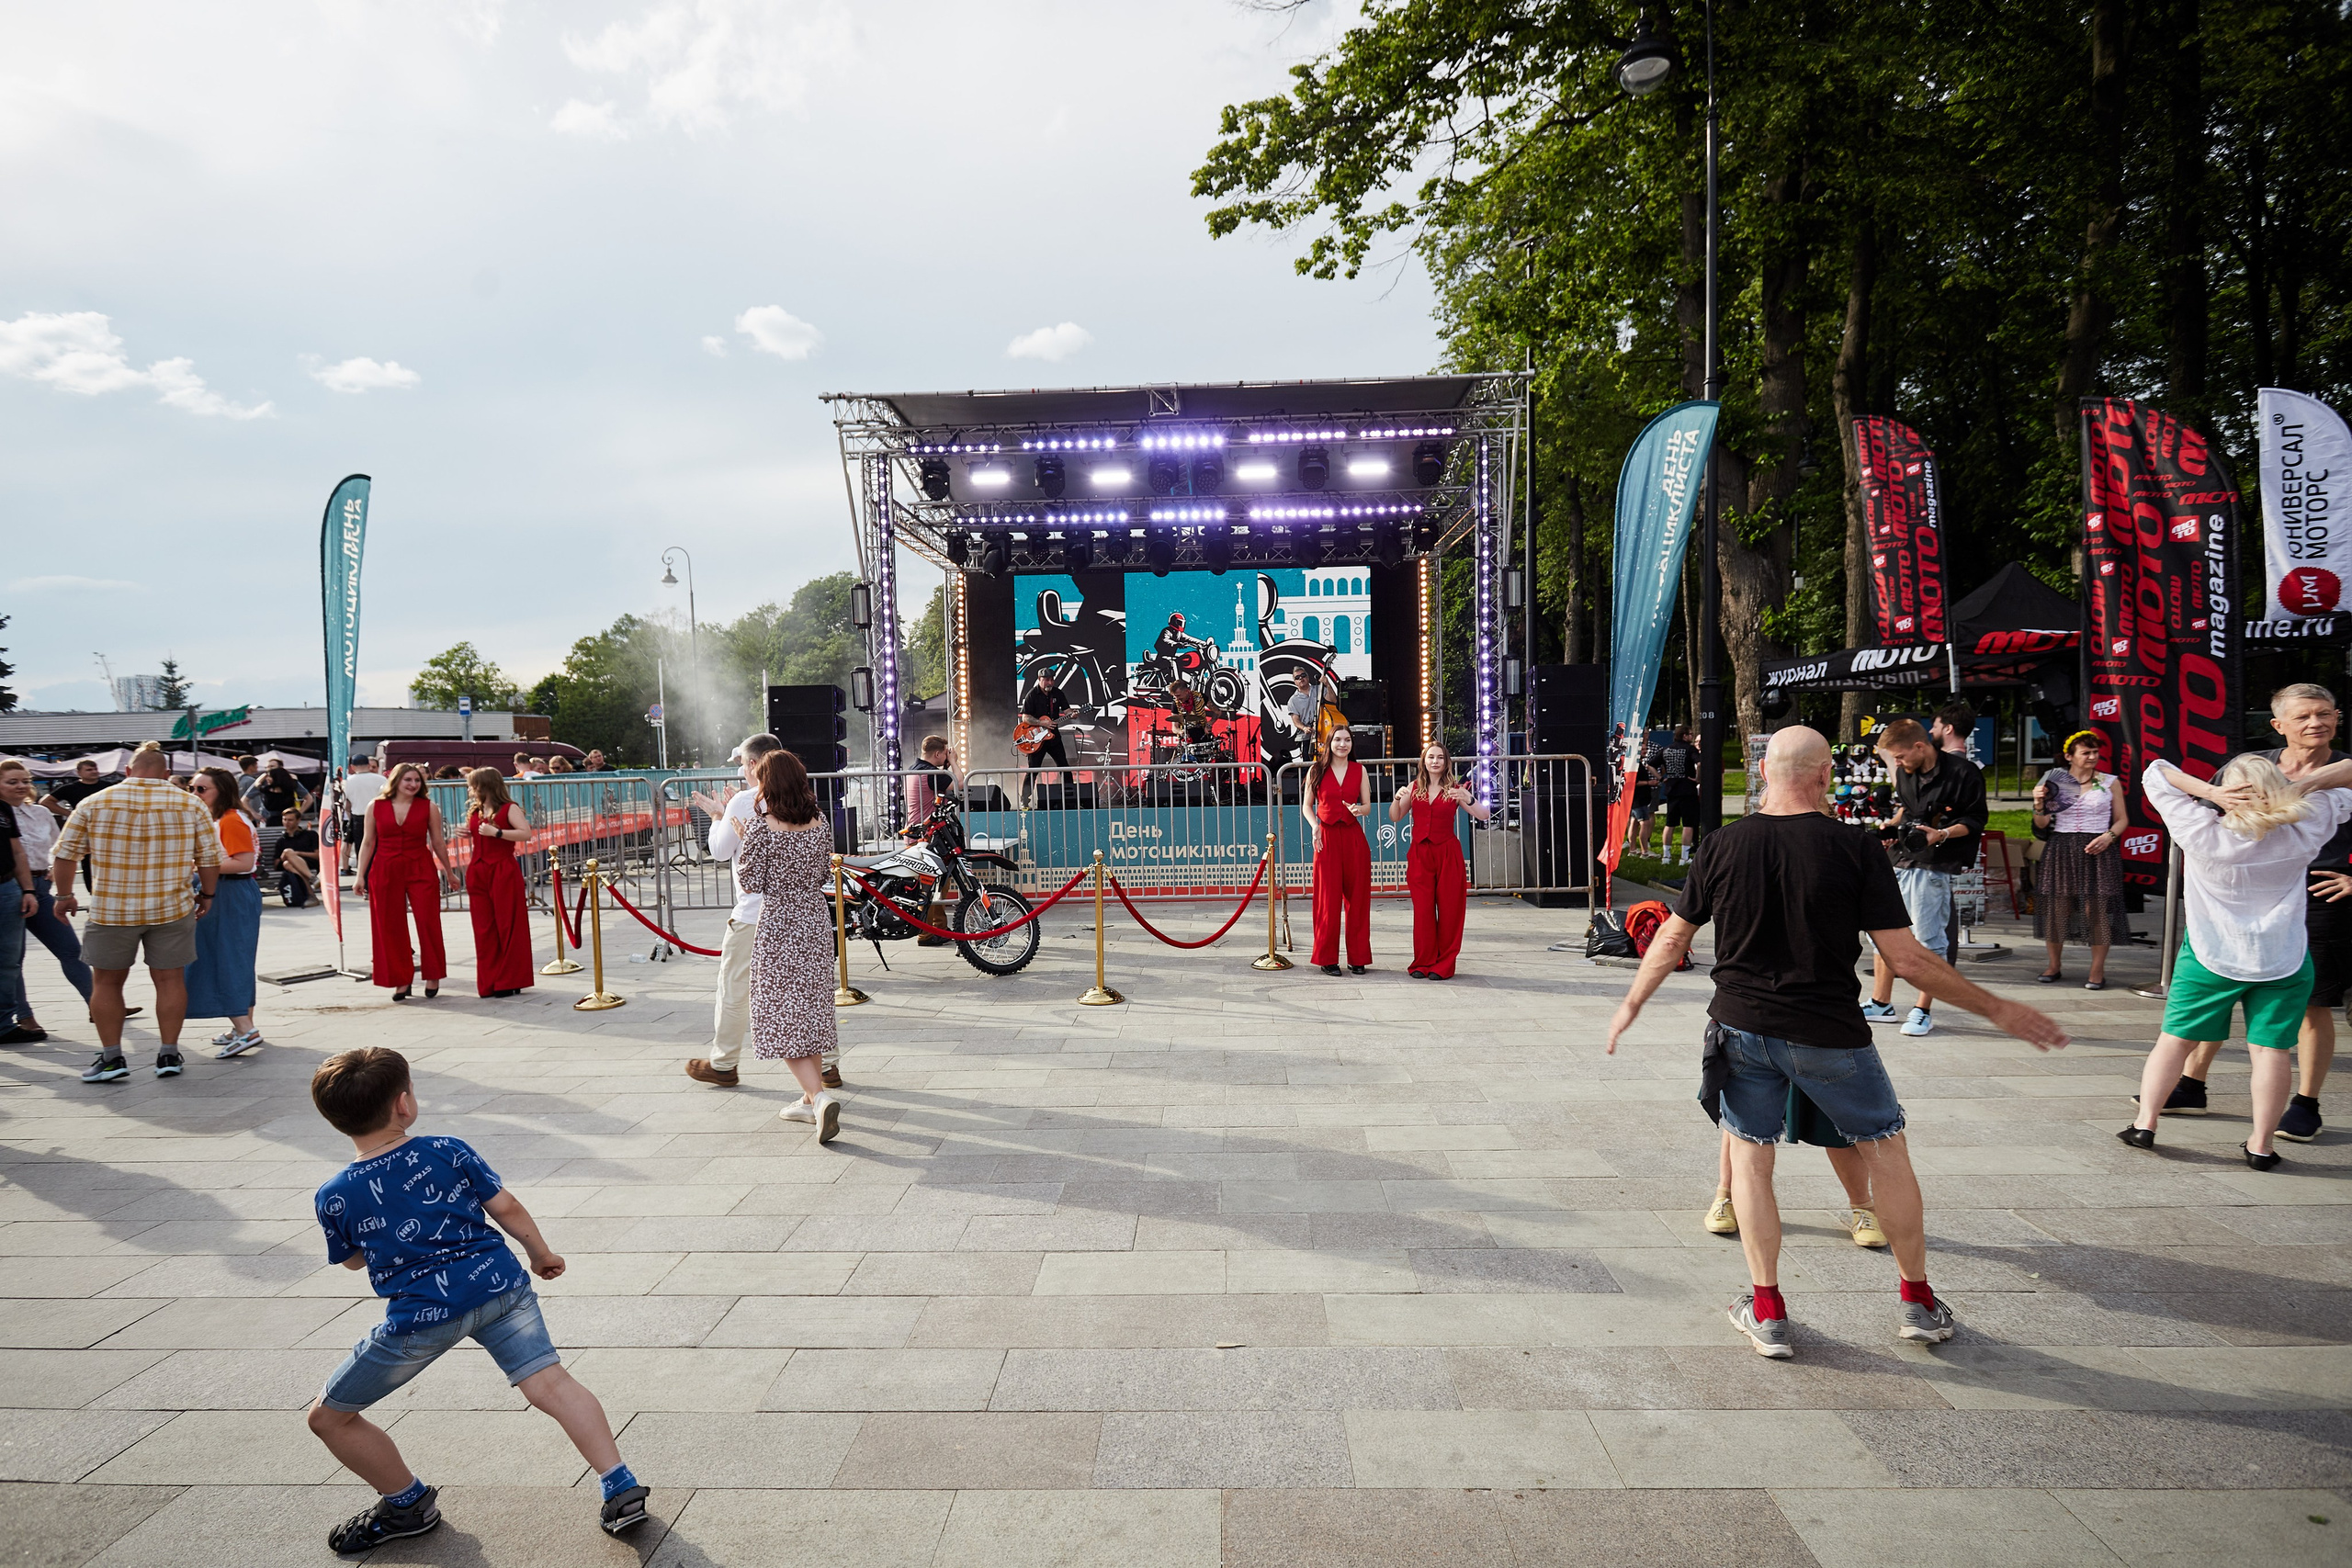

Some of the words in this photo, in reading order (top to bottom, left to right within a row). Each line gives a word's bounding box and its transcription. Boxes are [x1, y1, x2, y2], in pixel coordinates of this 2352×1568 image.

[1663, 429, 1682, 497] ДЕНЬ
[2090, 422, 2107, 505] MOTO
[2144, 410, 2161, 471] MOTO
[1924, 460, 1938, 528] magazine
[2105, 397, 2136, 546] MOTO
[1888, 460, 1908, 540] MOTO
[2305, 468, 2329, 559] МОТОРС
[344, 499, 355, 556] ДЕНЬ
[2171, 519, 2197, 535] MO
[2175, 526, 2196, 538] TO
[1898, 549, 1914, 613] MOTO
[1916, 526, 1945, 643] MOTO
[2119, 563, 2134, 637] MOTO
[2133, 502, 2166, 675] MOTO
[2170, 575, 2182, 629] MOTO
[2190, 560, 2203, 609] MOTO
[2205, 514, 2230, 659] magazine
[2090, 580, 2106, 656] MOTO
[1766, 661, 1828, 686] журнал
[2091, 674, 2162, 687] MOTO
[2093, 699, 2118, 711] MO
[2098, 706, 2118, 716] TO
[1109, 821, 1163, 841] День
[1110, 843, 1259, 861] мотоциклиста
[2124, 833, 2159, 848] MO
[2129, 842, 2158, 855] TO
[889, 855, 939, 874] SHARMAX
[2123, 873, 2157, 885] TO
[357, 1216, 387, 1234] PARTY
[399, 1221, 416, 1237] HEY
[413, 1307, 448, 1324] PARTY
